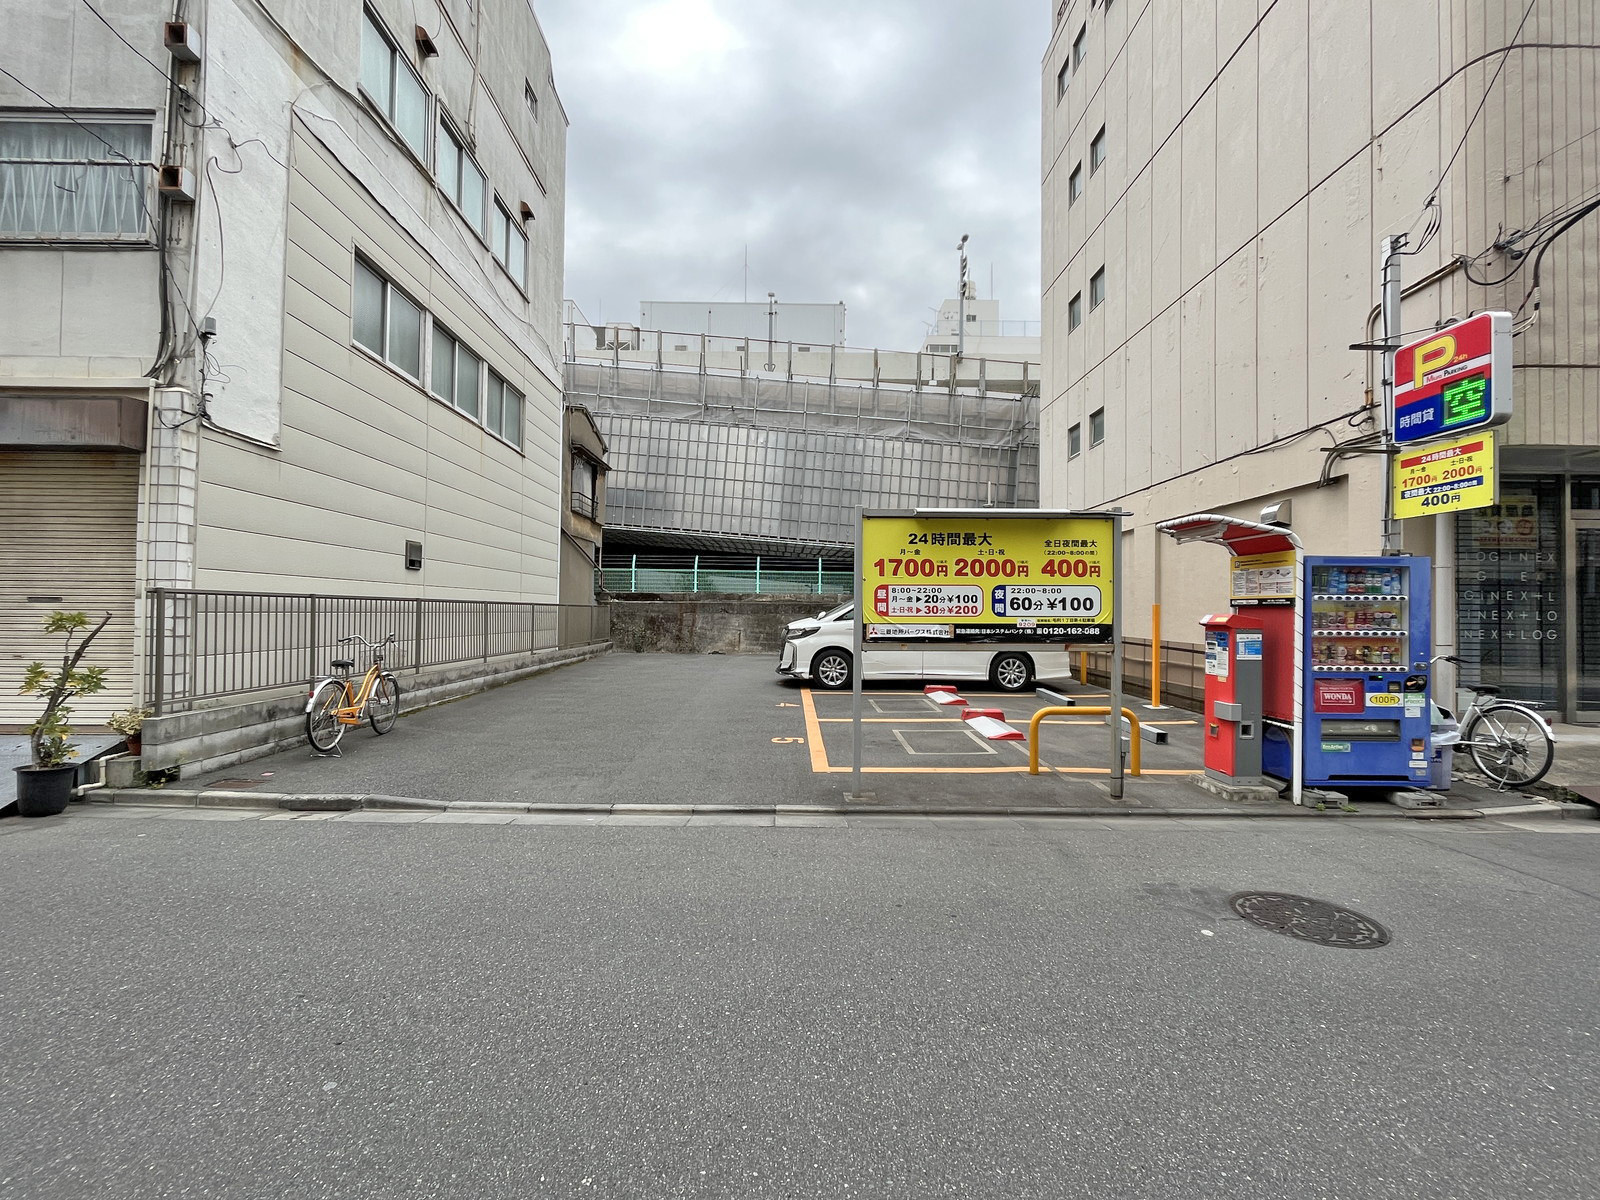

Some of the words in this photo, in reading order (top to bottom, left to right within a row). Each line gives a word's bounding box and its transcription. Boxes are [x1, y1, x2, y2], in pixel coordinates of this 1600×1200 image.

[1413, 334, 1456, 391] P
[1444, 379, 1486, 425] 空
[1399, 407, 1434, 429] 時間貸
[1420, 448, 1462, 463] 24時間最大
[1442, 465, 1482, 480] 2000円
[1402, 474, 1437, 488] 1700円
[1404, 487, 1432, 499] 夜間最大
[1421, 493, 1461, 507] 400円
[908, 532, 993, 546] 24時間最大
[1044, 539, 1098, 548] 全日夜間最大
[873, 558, 948, 577] 1700円
[954, 558, 1029, 577] 2000円
[1041, 558, 1101, 578] 400円
[877, 589, 887, 613] 昼間
[994, 589, 1005, 613] 夜間
[1323, 692, 1352, 700] WONDA
[1374, 696, 1396, 704] 100円
